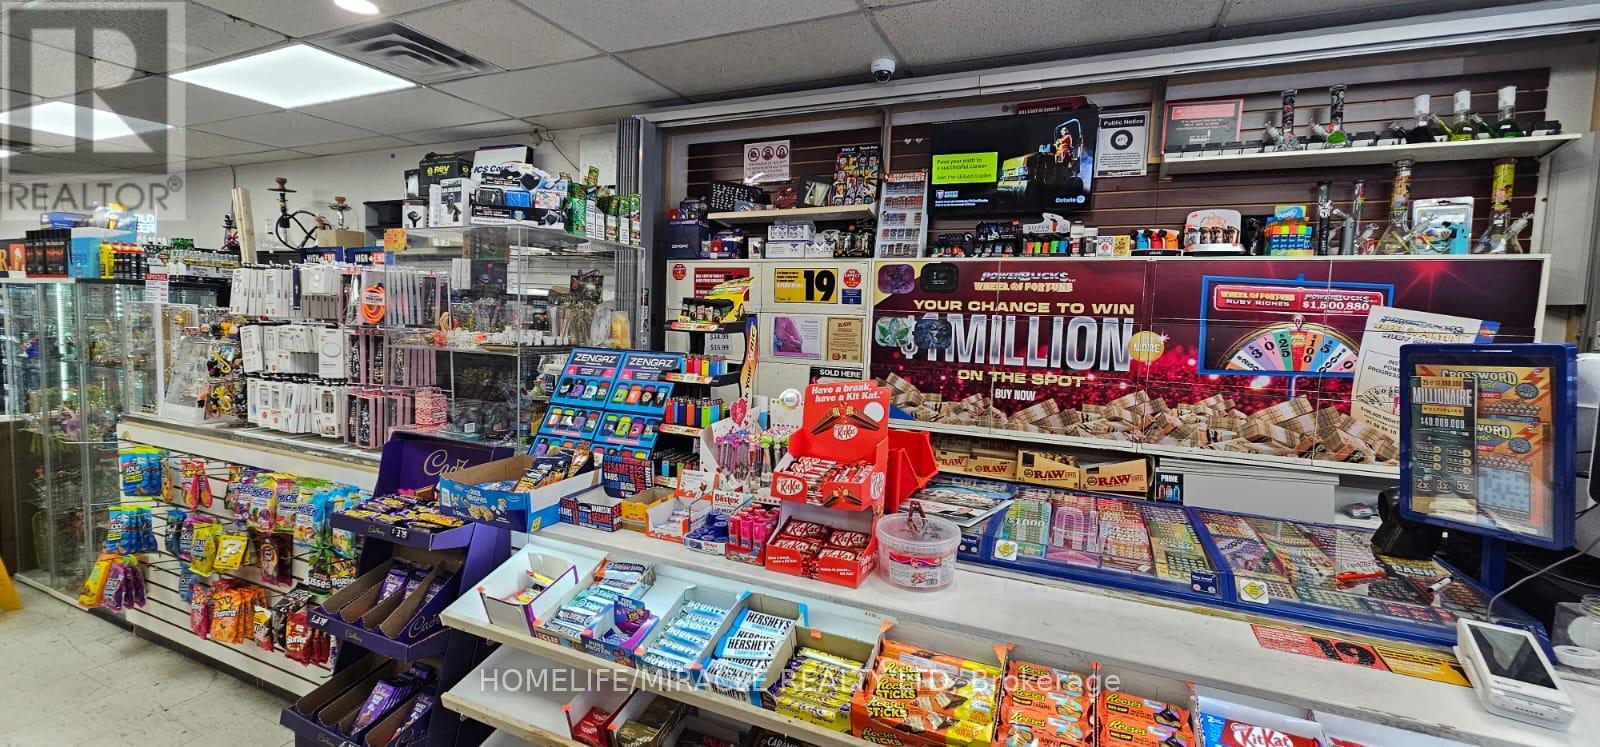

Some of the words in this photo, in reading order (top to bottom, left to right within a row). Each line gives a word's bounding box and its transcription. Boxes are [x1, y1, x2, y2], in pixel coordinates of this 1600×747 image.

[803, 269, 836, 302] 19
[974, 281, 1010, 291] WHEEL
[1024, 282, 1073, 293] FORTUNE
[914, 299, 963, 311] YOUR
[967, 300, 1050, 313] CHANCE
[1057, 302, 1085, 314] TO
[1092, 303, 1135, 315] WIN
[1255, 299, 1290, 307] RICHES
[1134, 342, 1160, 353] MORE
[958, 369, 985, 381] ON
[991, 371, 1026, 385] THE
[1032, 373, 1086, 388] SPOT
[1441, 369, 1517, 387] CROSSWORD
[812, 386, 833, 395] Have
[843, 383, 872, 392] break,
[995, 388, 1013, 400] BUY
[1014, 389, 1036, 401] NOW
[815, 394, 836, 403] have
[846, 391, 860, 401] Kit
[1412, 386, 1473, 408] MILLIONAIRE
[1423, 406, 1463, 414] MULTIPLIER
[942, 458, 964, 466] RAW
[982, 464, 1008, 473] RAW
[1034, 469, 1065, 479] RAW
[1098, 474, 1132, 487] RAW
[1160, 474, 1179, 483] PRIME
[780, 477, 803, 494] KitKat
[790, 522, 821, 536] KitKat
[834, 532, 866, 545] KitKat
[687, 600, 727, 615] BOUNTY
[660, 638, 699, 656] BOUNTY
[1311, 636, 1376, 667] 19
